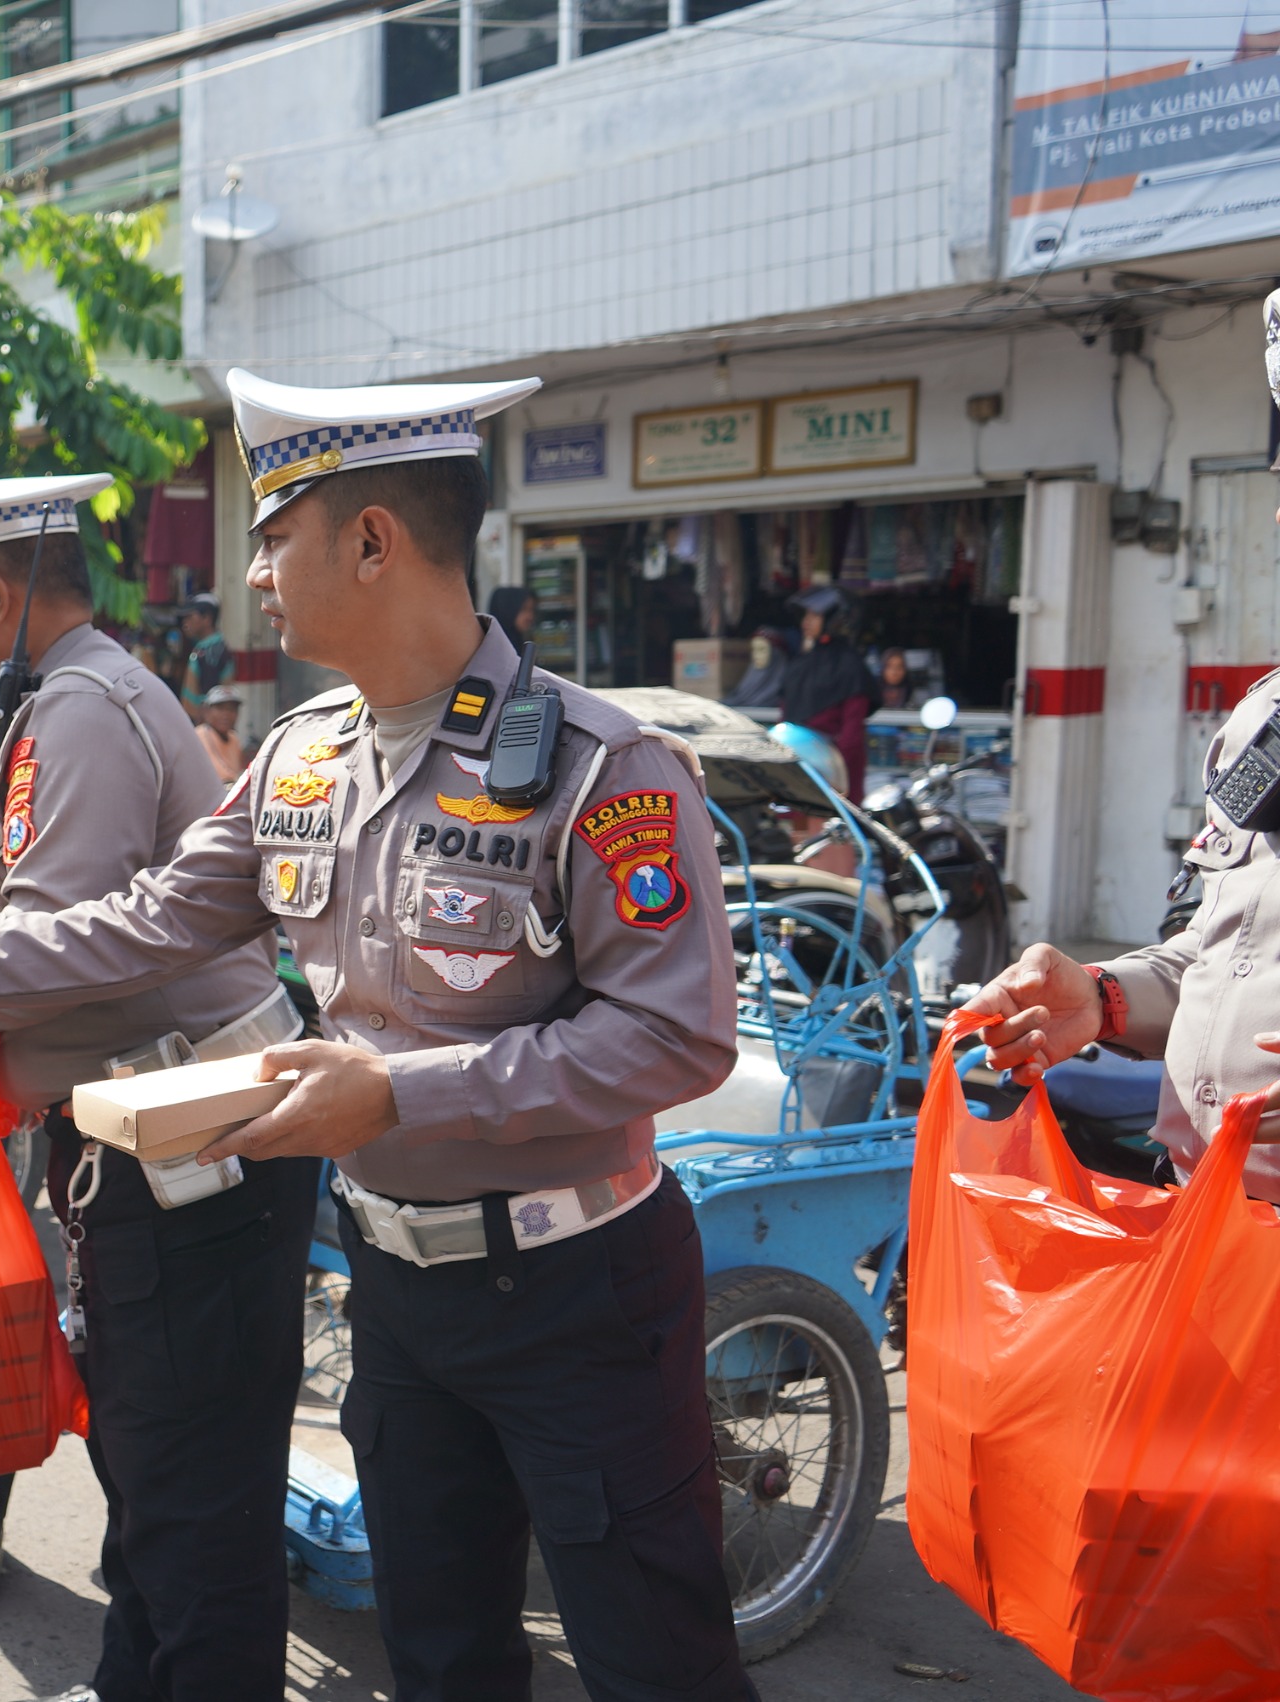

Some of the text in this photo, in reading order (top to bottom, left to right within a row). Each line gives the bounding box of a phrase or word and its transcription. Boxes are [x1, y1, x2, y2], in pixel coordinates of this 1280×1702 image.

[1084, 130, 1133, 158] Wali
[1138, 123, 1193, 148] Kota
[806, 407, 891, 441] MINI
[584, 795, 668, 832] POLRES
[589, 806, 670, 839] PROBOLINGGO KOTA
[412, 824, 530, 870] POLRI
[605, 829, 669, 856] JAWA TIMUR
